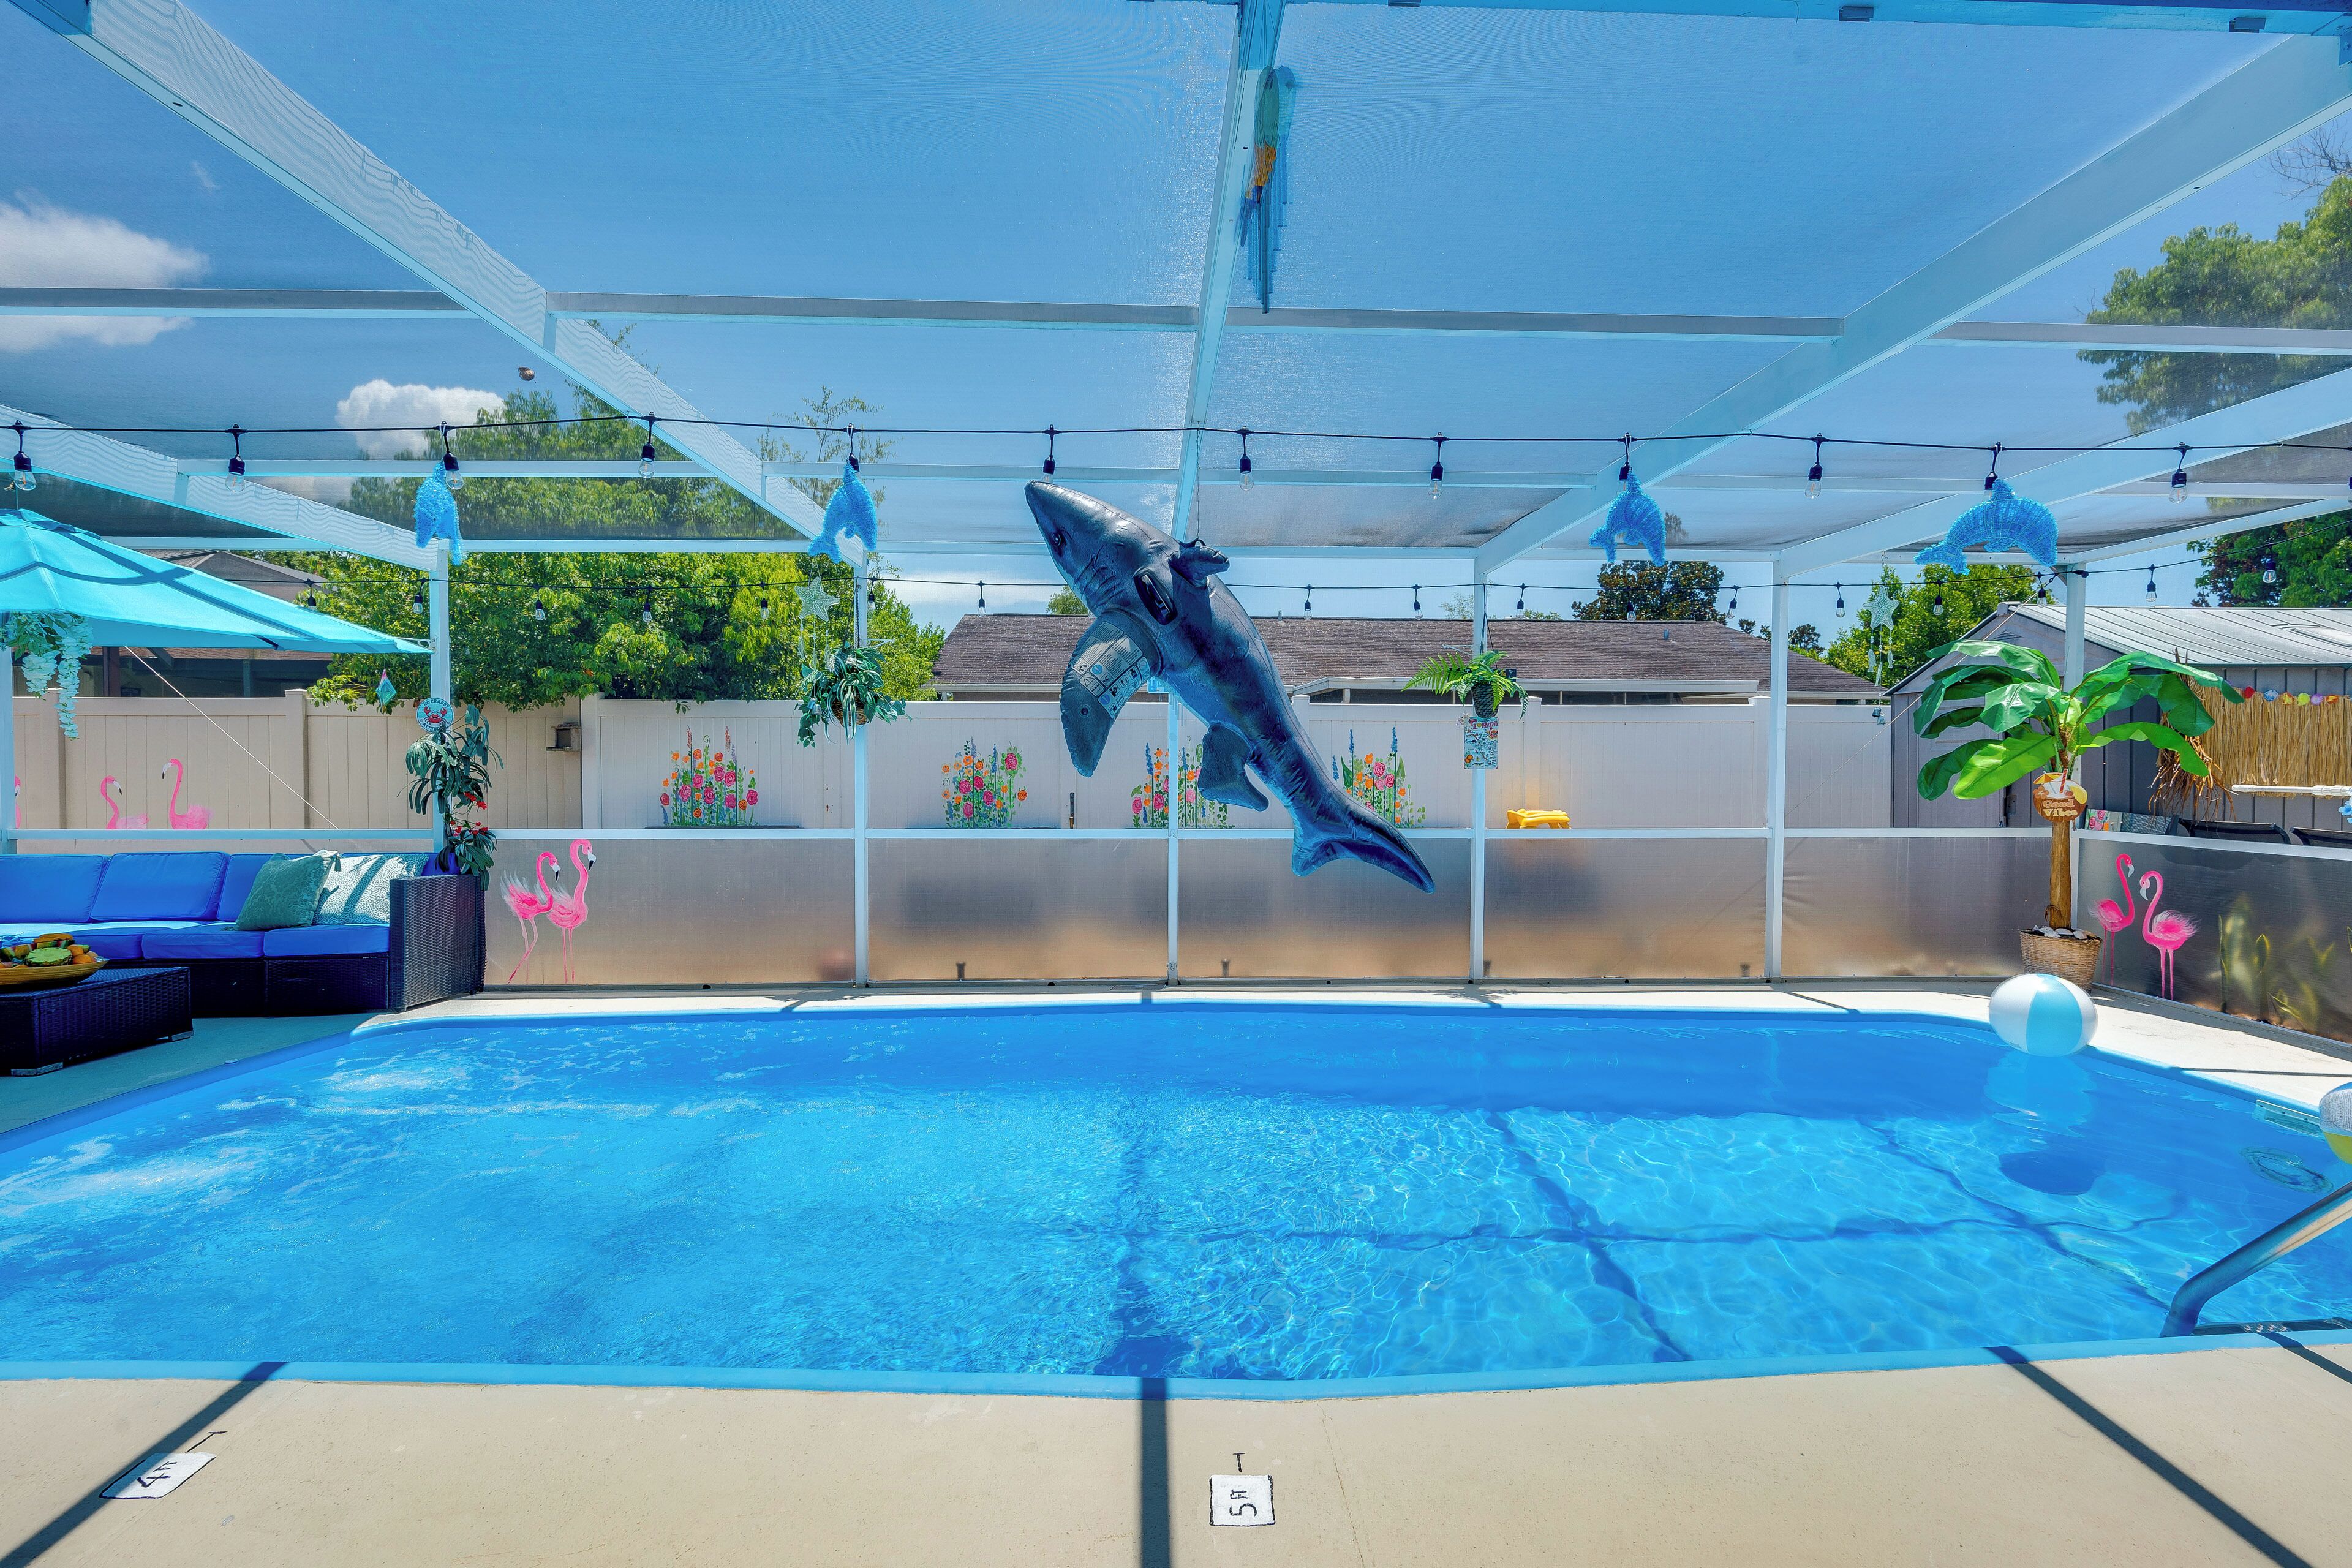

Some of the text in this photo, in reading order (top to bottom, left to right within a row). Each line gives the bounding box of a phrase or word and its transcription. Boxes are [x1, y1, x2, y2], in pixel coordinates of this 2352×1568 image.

[431, 699, 450, 708] CRABBY
[422, 723, 440, 731] ATTITUD
[2042, 799, 2075, 809] Good
[2043, 809, 2078, 817] Vibes
